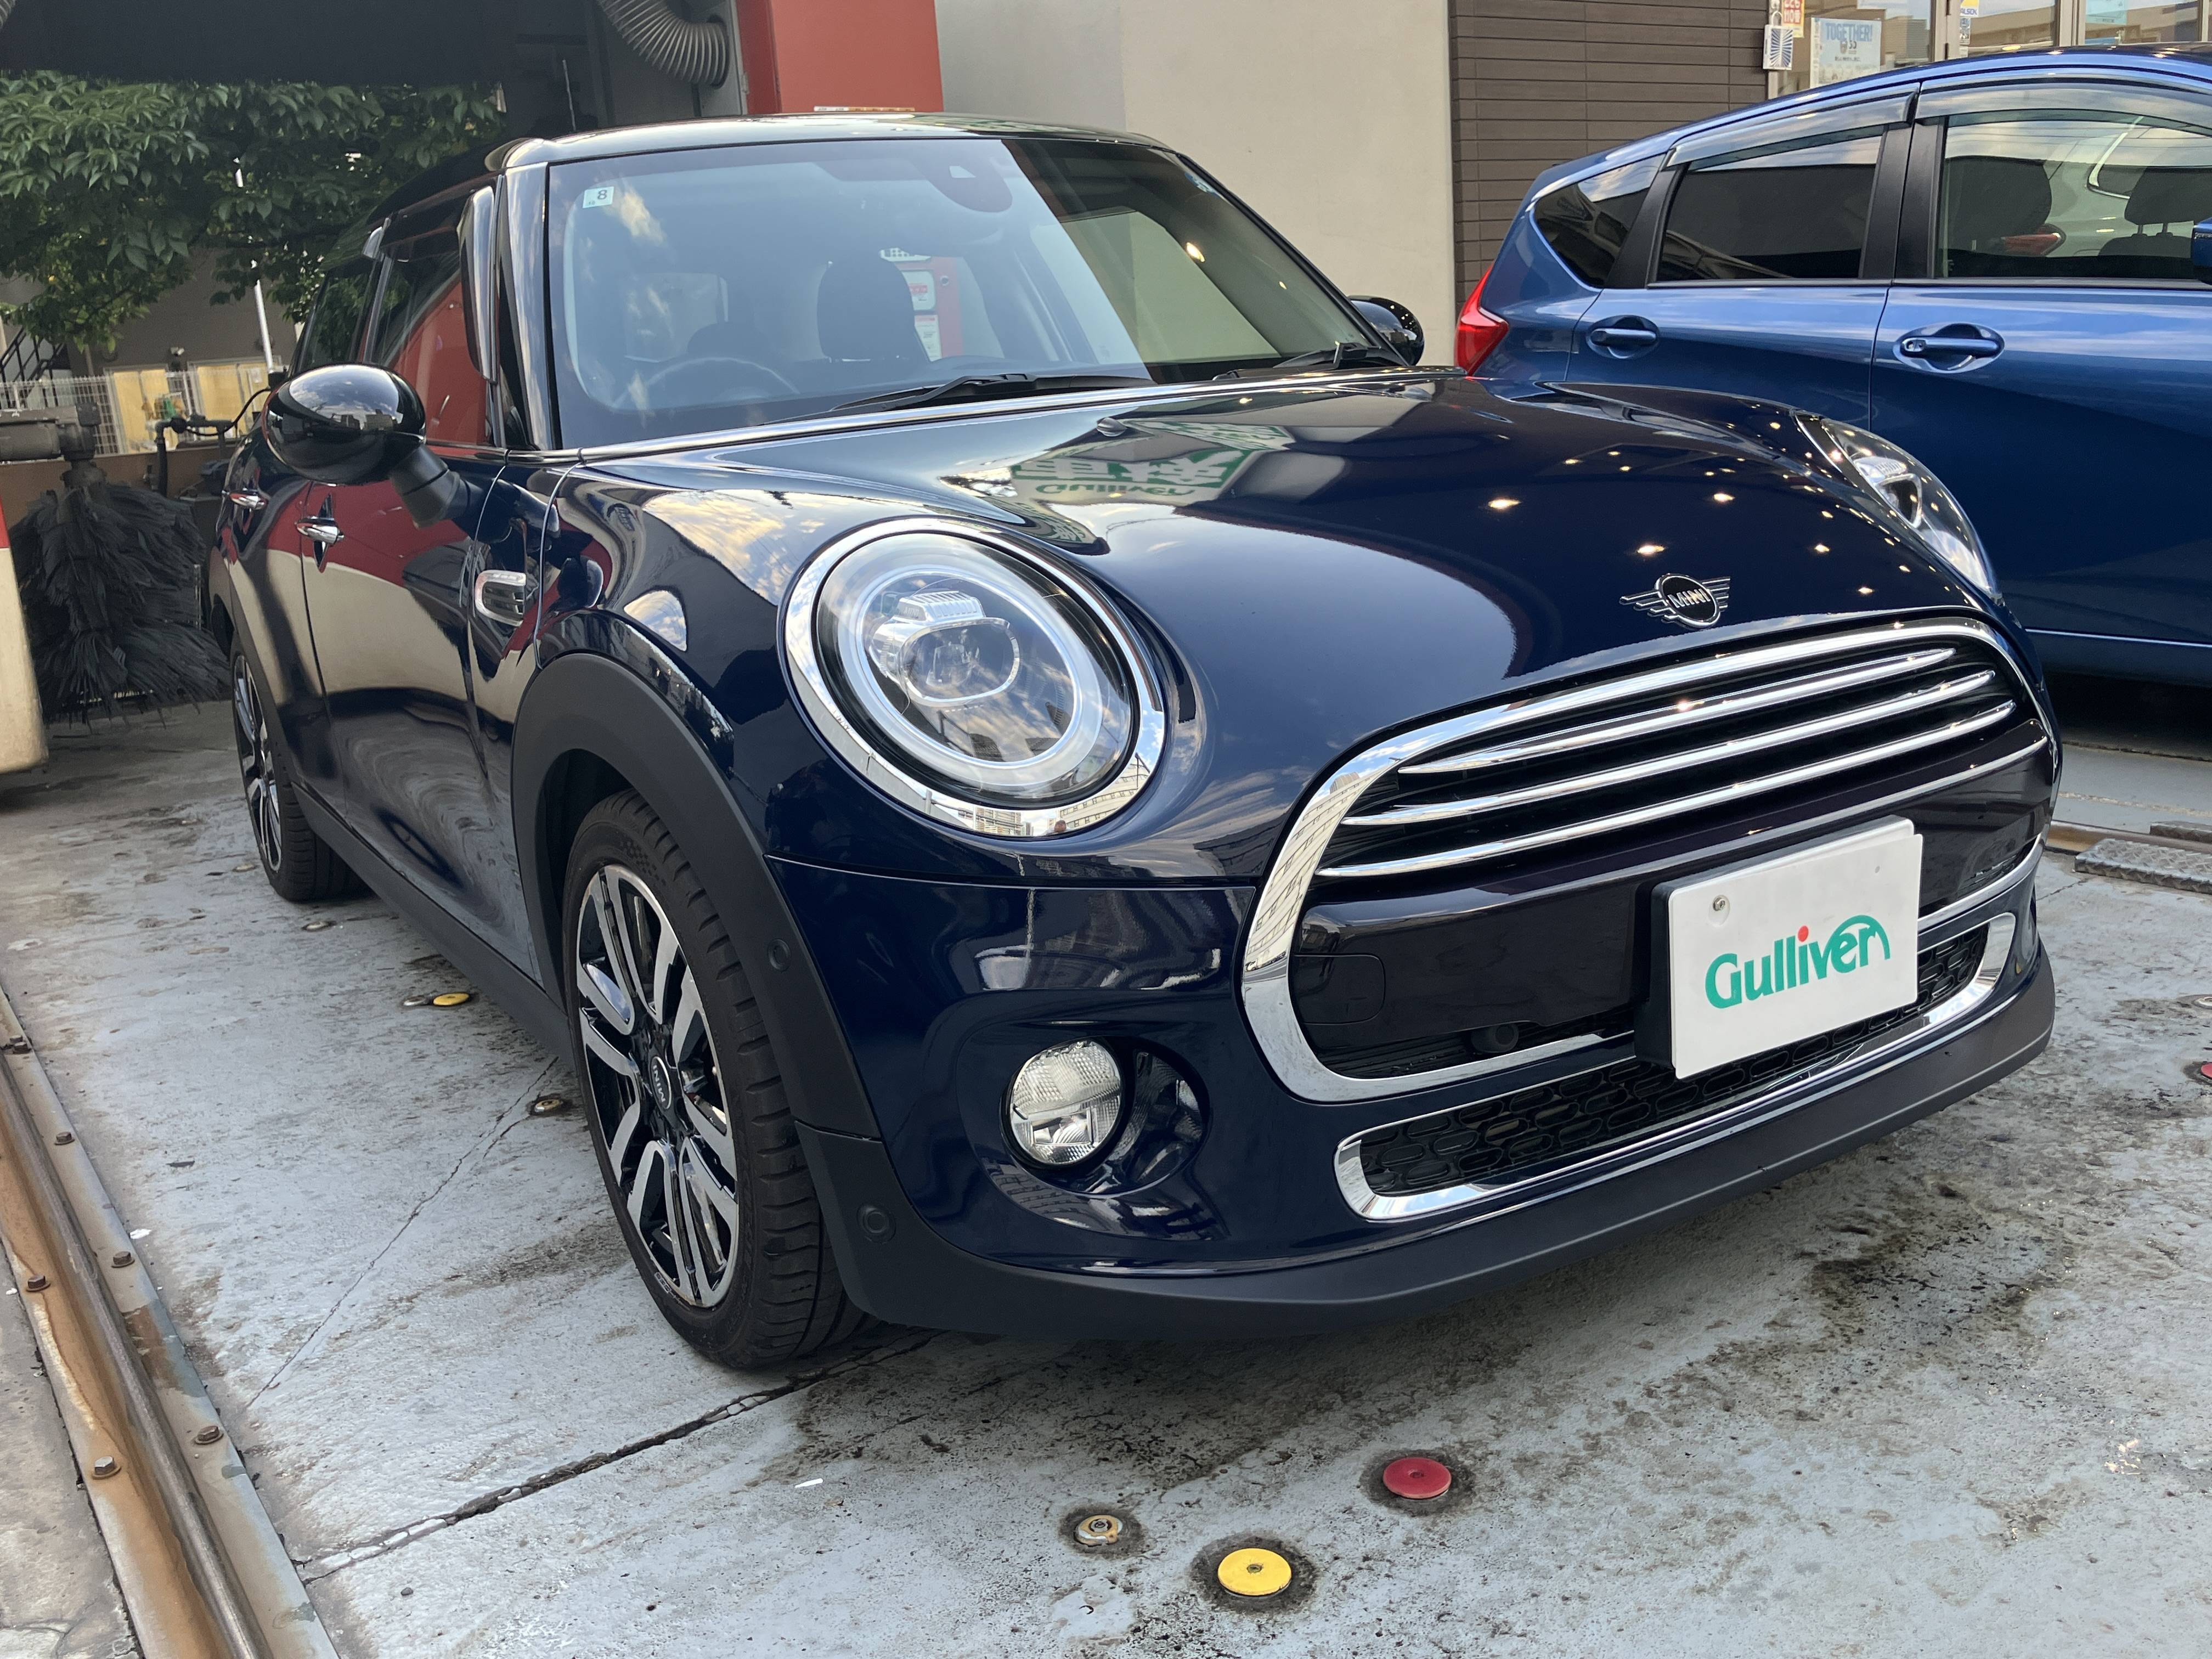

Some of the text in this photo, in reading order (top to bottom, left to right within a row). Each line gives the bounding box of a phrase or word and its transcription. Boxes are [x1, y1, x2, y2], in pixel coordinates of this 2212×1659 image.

[1825, 22, 1872, 42] TOGETHER!
[597, 189, 607, 200] 8
[1668, 589, 1711, 608] MINI
[1705, 915, 1891, 1008] Gulliver
[653, 1065, 666, 1102] MINI
